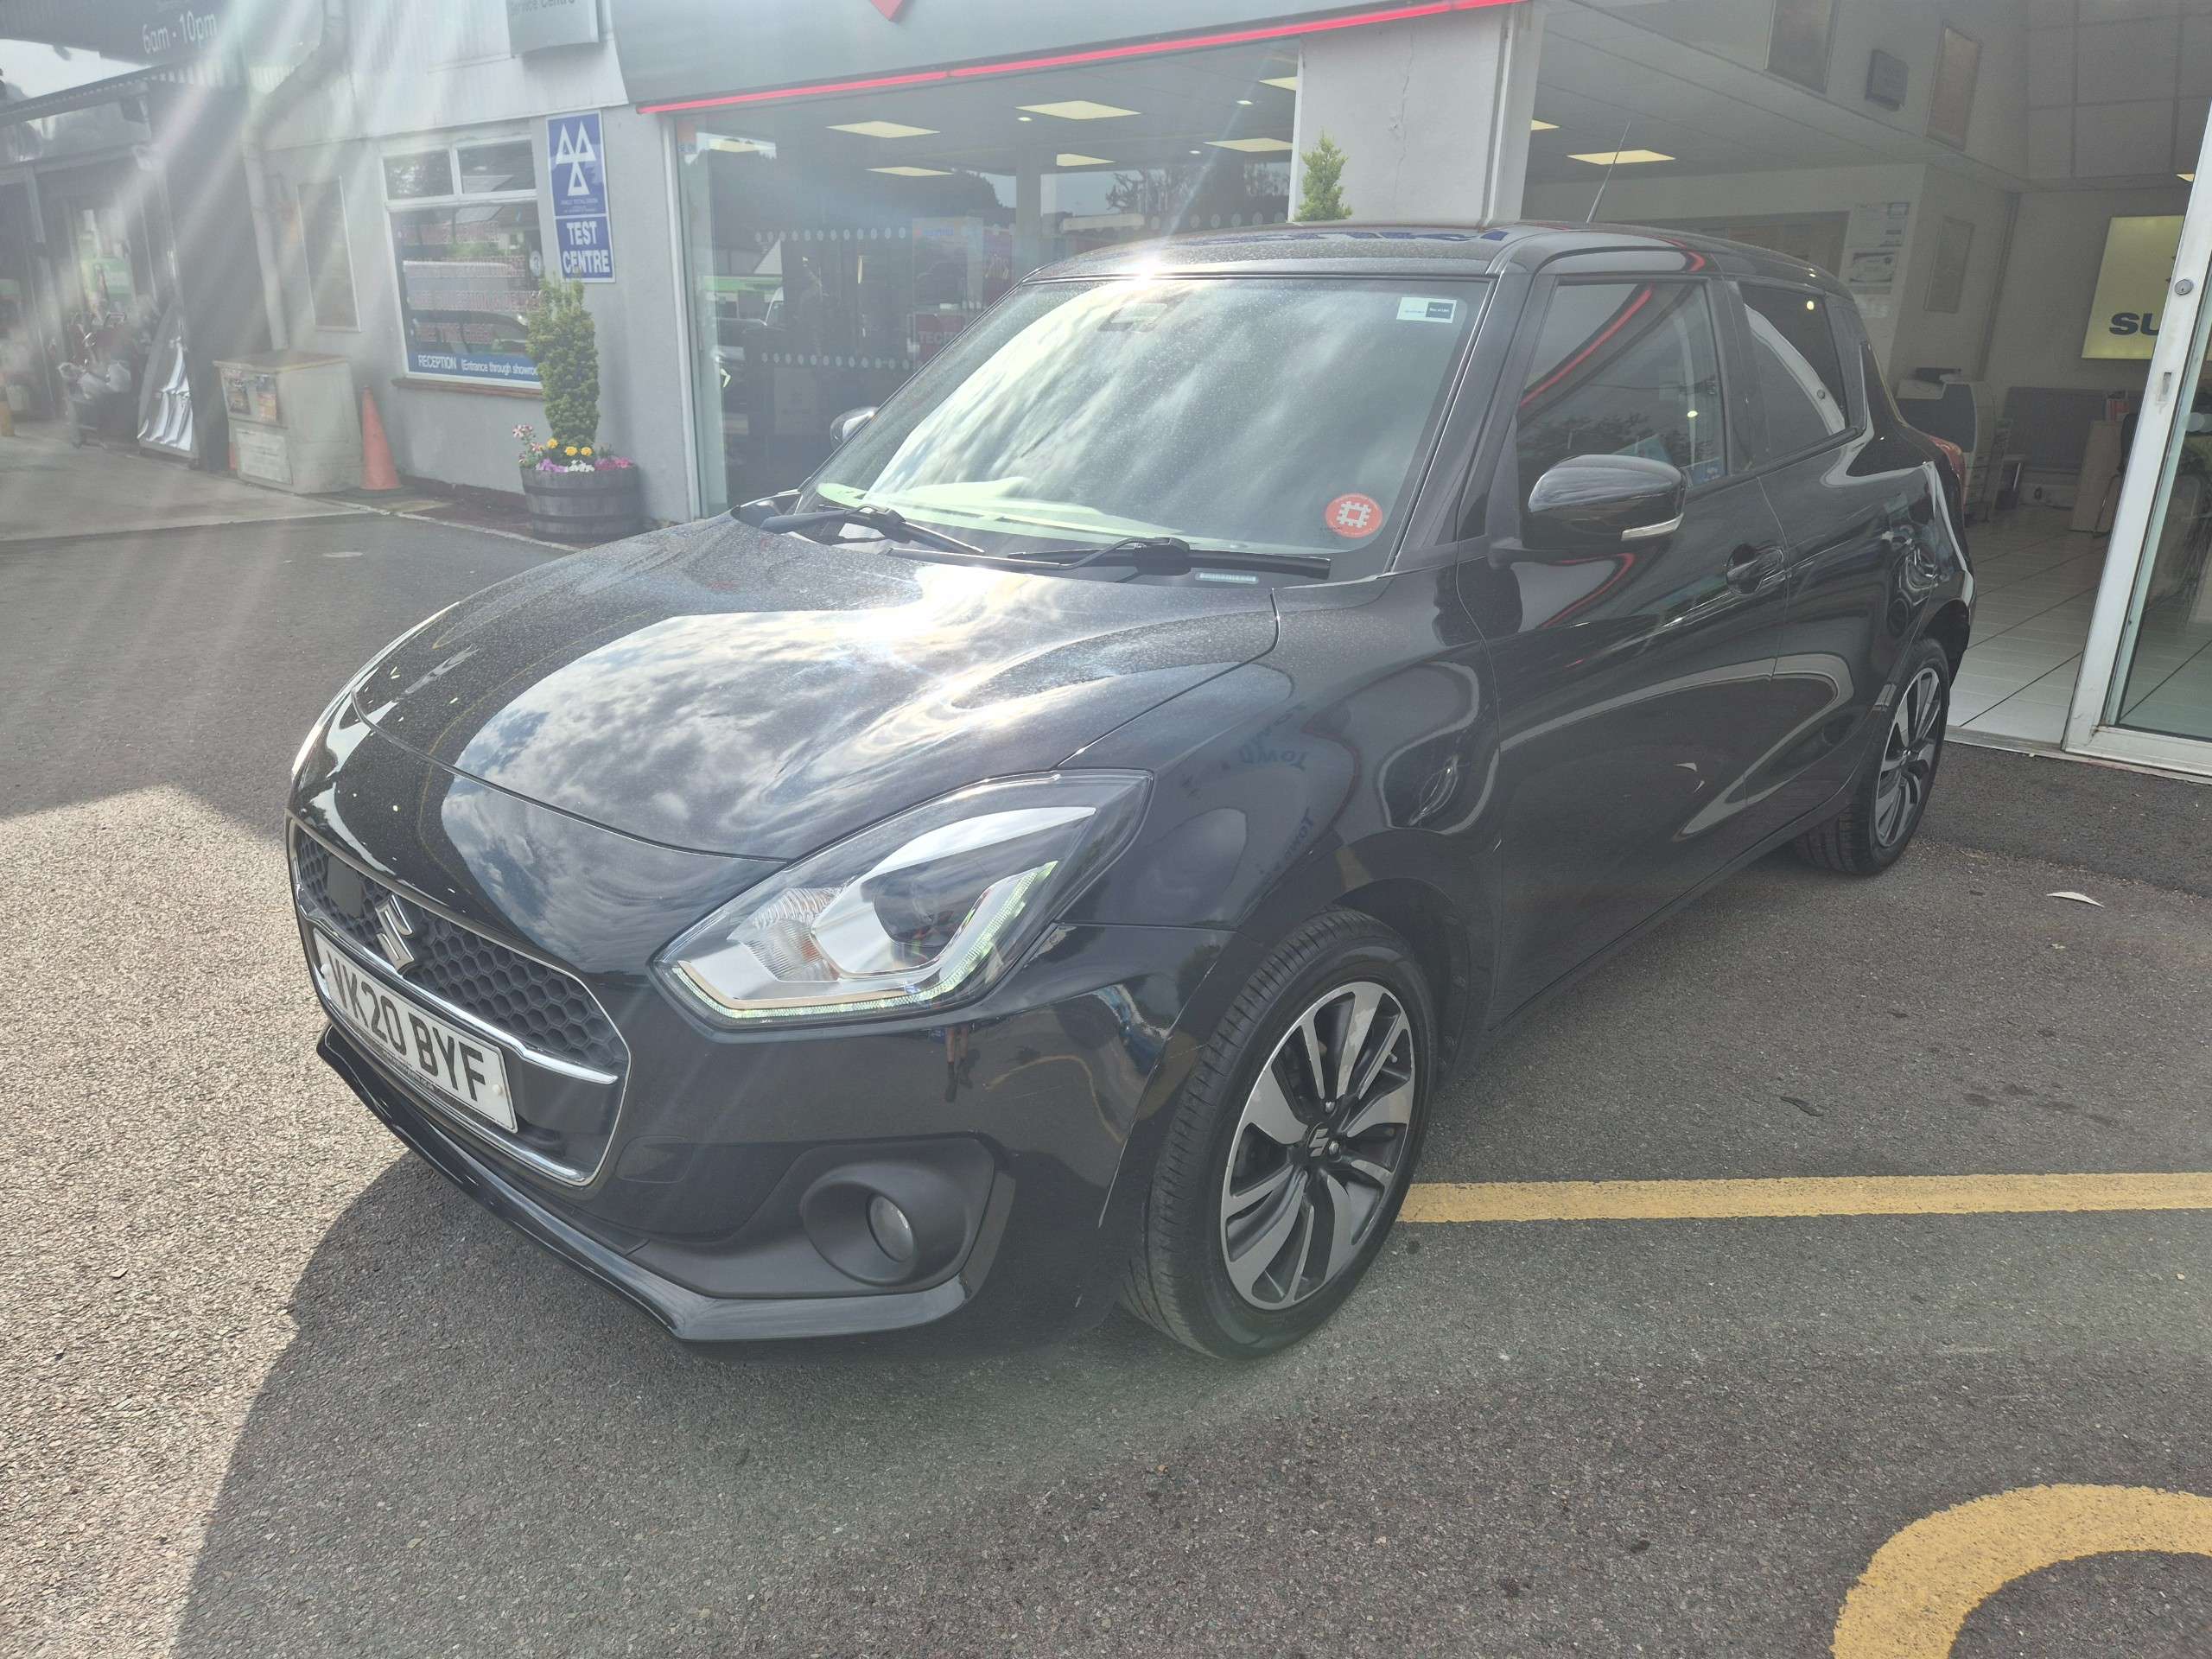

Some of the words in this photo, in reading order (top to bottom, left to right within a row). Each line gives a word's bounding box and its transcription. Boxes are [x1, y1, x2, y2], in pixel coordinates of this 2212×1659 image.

[142, 23, 171, 54] 6am
[179, 10, 218, 48] 10pm
[566, 221, 597, 246] TEST
[563, 249, 610, 276] CENTRE
[418, 355, 457, 370] RECEPTION
[489, 361, 512, 376] through
[326, 950, 407, 1055] VK20
[408, 1011, 486, 1102] BYF
